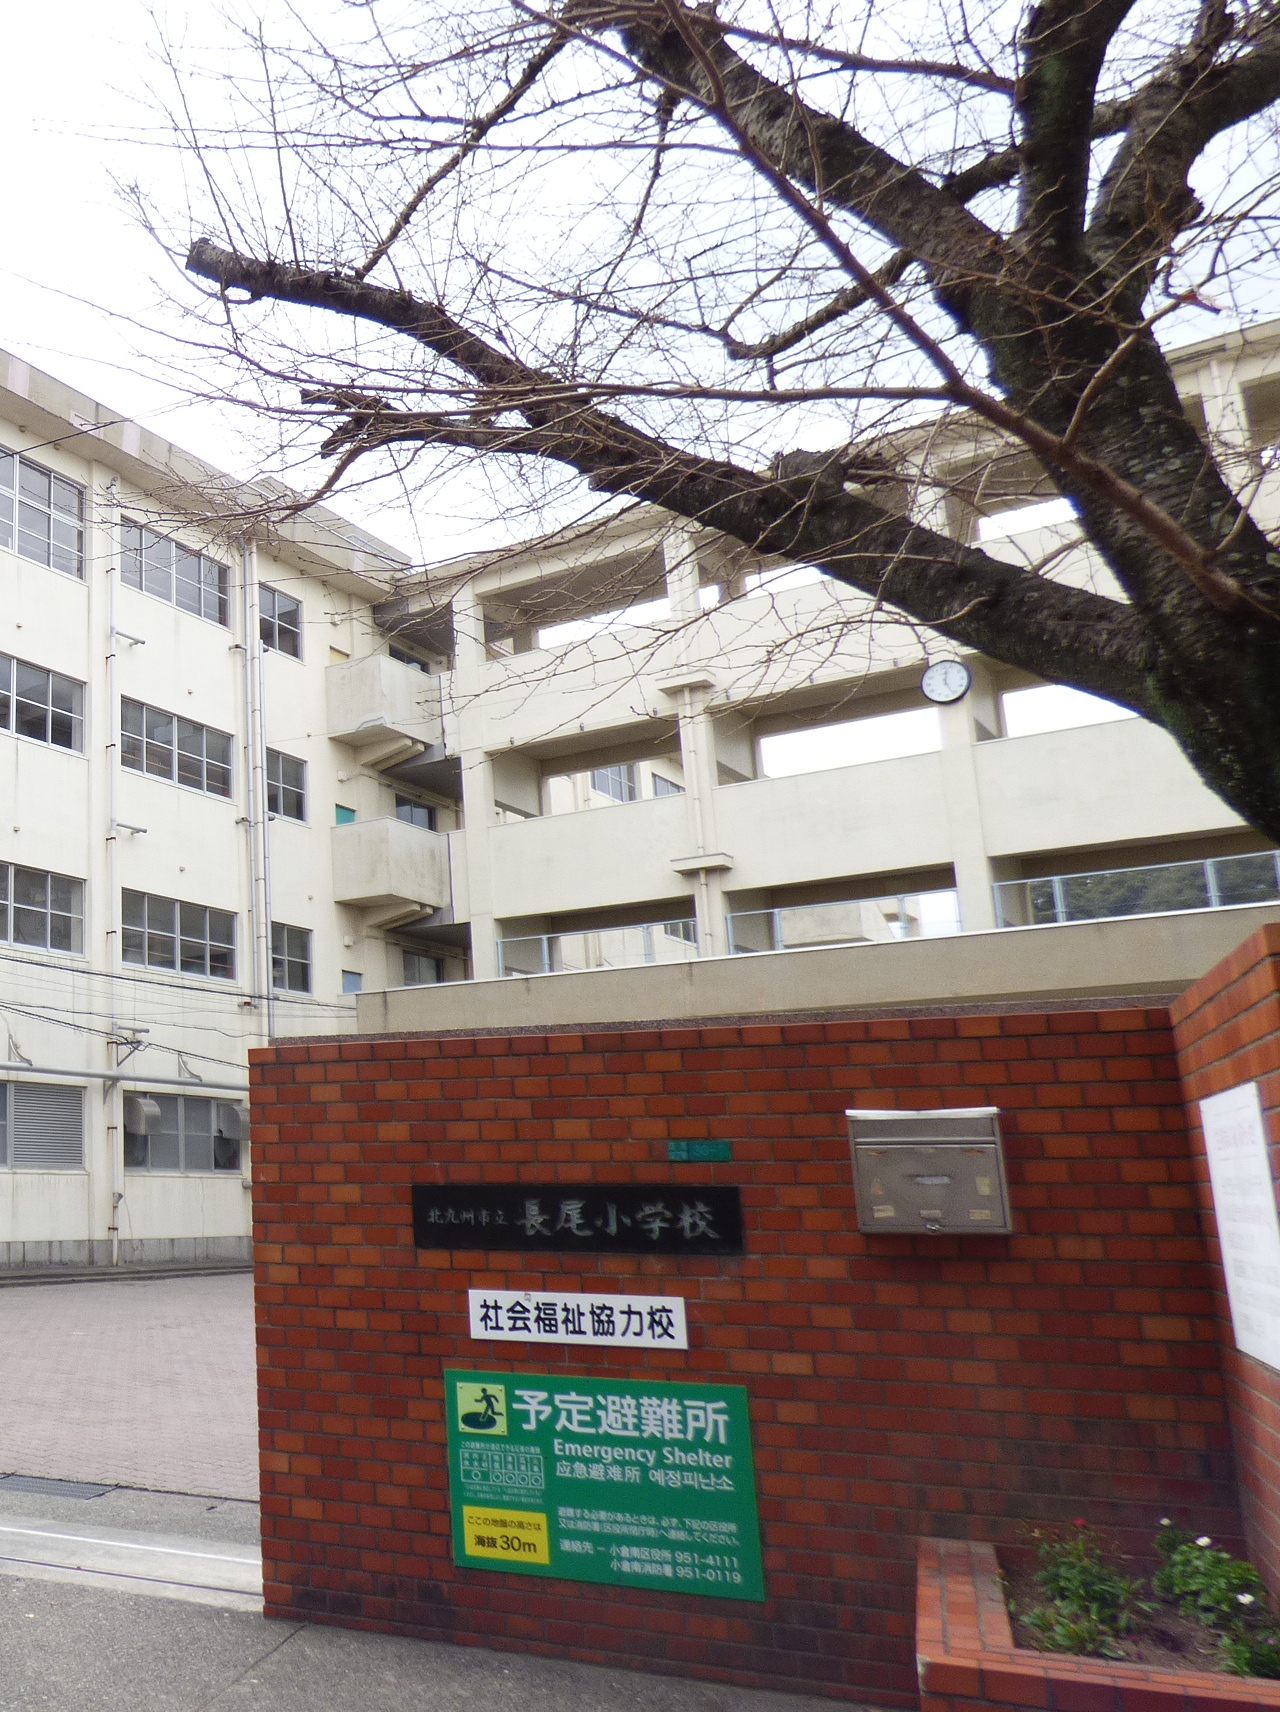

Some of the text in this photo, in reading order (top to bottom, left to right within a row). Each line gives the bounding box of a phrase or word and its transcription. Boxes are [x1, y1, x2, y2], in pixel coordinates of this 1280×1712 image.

[426, 1198, 720, 1240] 北九州市立 長尾小学校
[479, 1298, 676, 1340] 社会福祉協力校
[512, 1389, 730, 1444] 予定避難所
[554, 1439, 656, 1464] Emergency
[663, 1447, 732, 1469] Shelter
[648, 1468, 736, 1491] 예정피난소
[560, 1539, 738, 1569] 連絡先 小倉南区役所 951-4111
[675, 1566, 742, 1584] 951-0119
